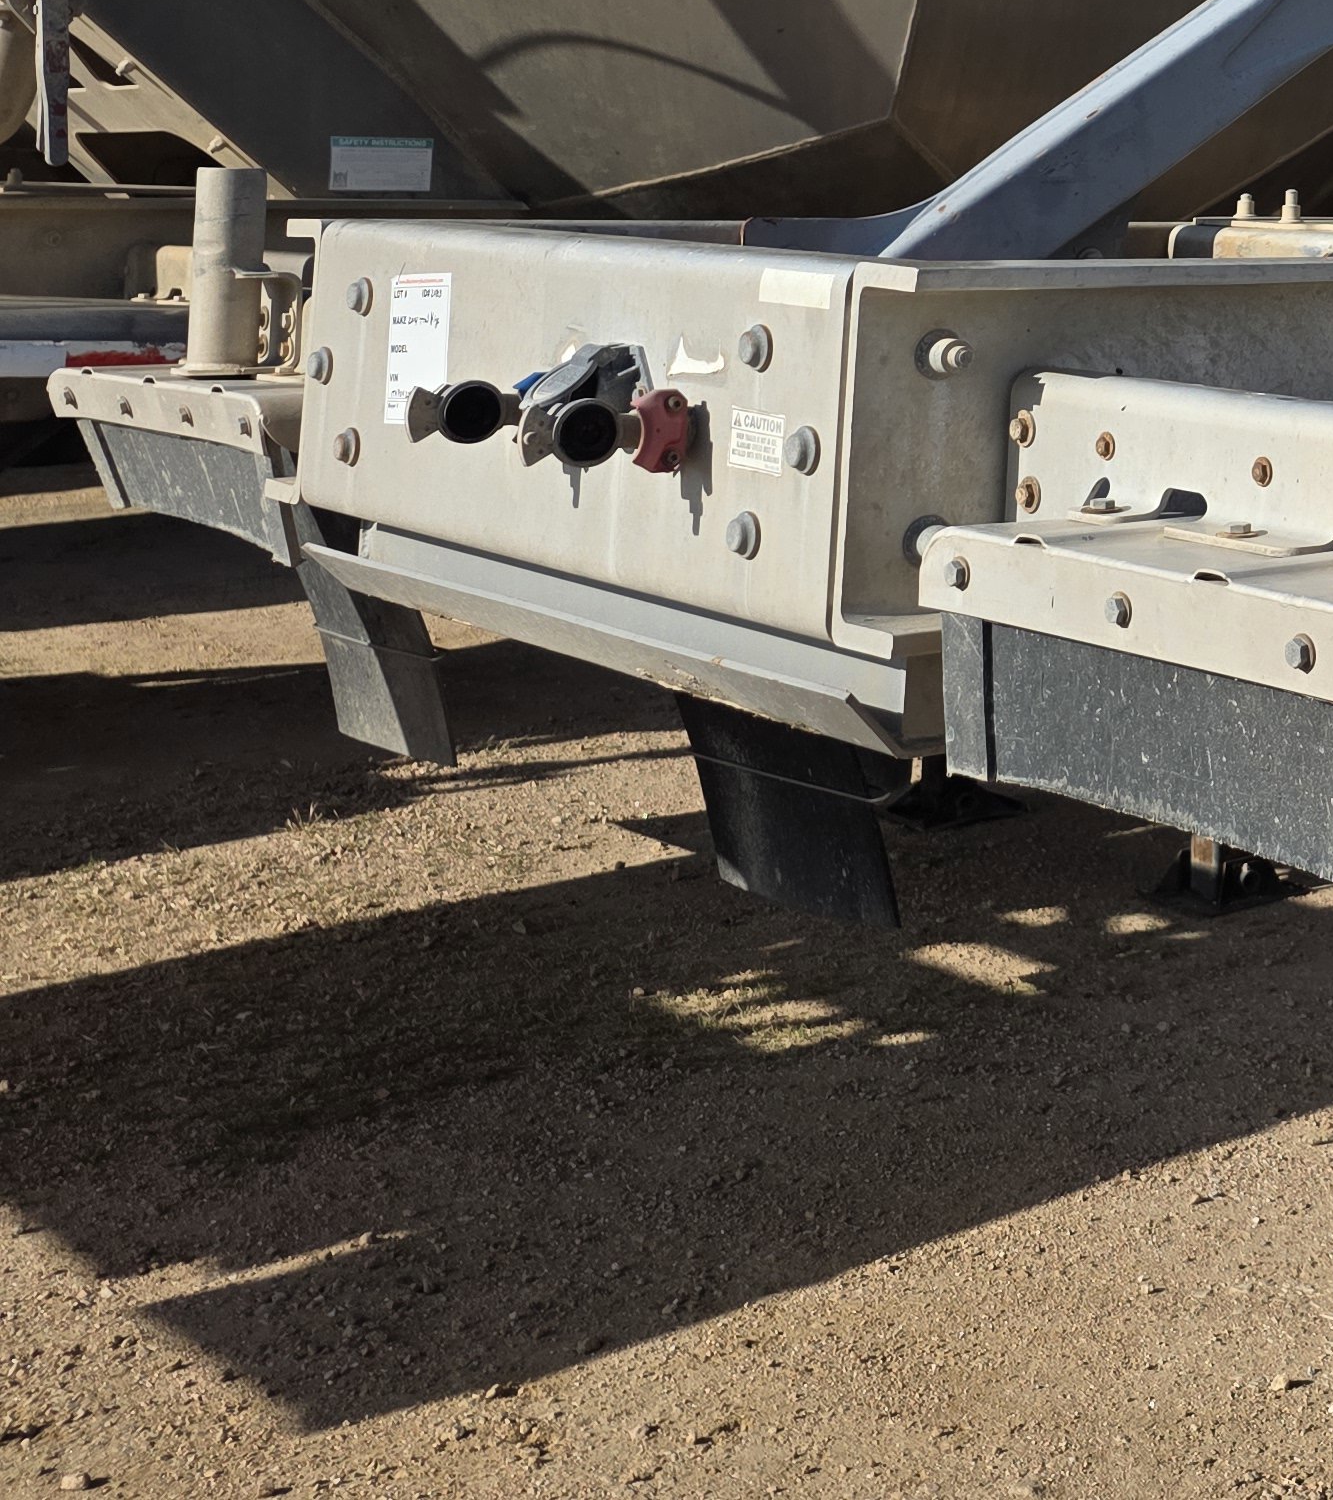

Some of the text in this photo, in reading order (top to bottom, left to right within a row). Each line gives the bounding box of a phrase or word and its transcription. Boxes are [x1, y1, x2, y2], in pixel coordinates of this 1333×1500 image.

[339, 138, 427, 147] SAFETY INSTRUCTIONS
[393, 289, 404, 298] LOT
[392, 315, 407, 324] MAKE
[390, 344, 408, 353] MODEL
[389, 373, 399, 382] VIN
[744, 414, 782, 434] CAUTION
